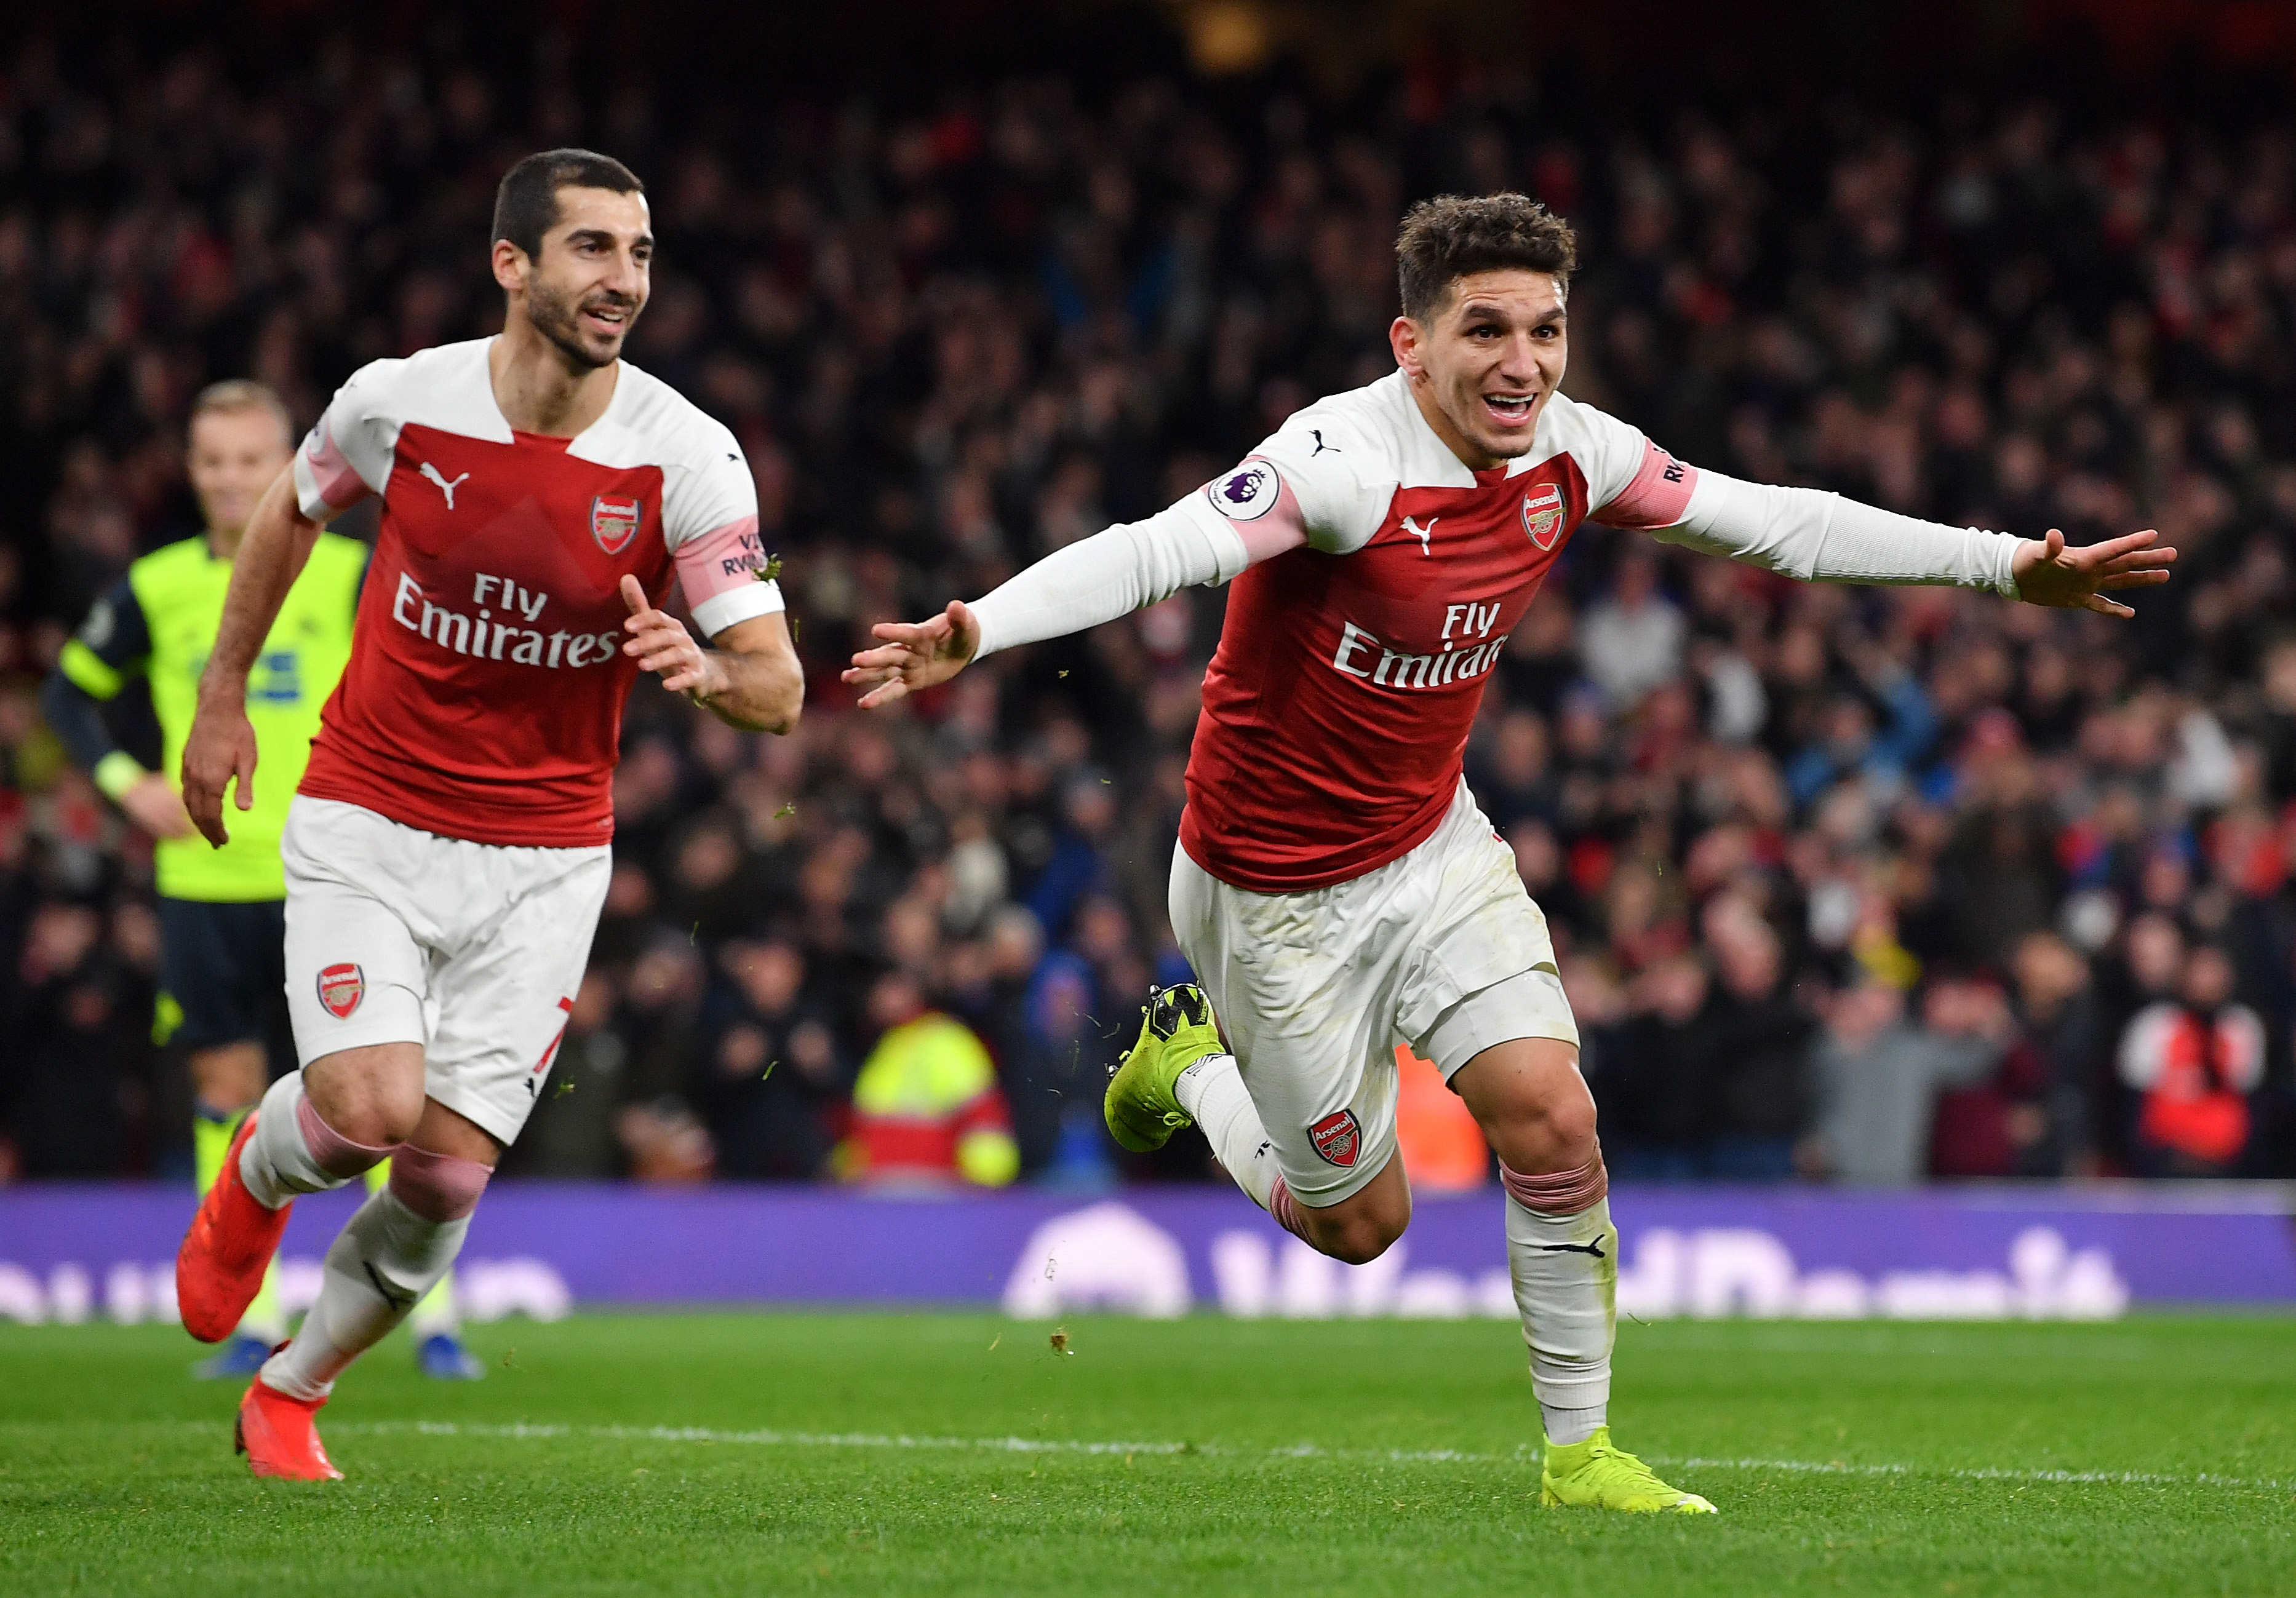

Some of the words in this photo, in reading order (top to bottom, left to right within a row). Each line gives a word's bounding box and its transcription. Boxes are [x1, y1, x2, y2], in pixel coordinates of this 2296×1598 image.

[1526, 491, 1559, 509] Arsenal
[472, 572, 548, 622] Fly
[393, 570, 619, 669] Emirates
[1441, 602, 1501, 639] Fly
[1333, 621, 1509, 688] Emirat
[1315, 1116, 1351, 1141] Arsenal
